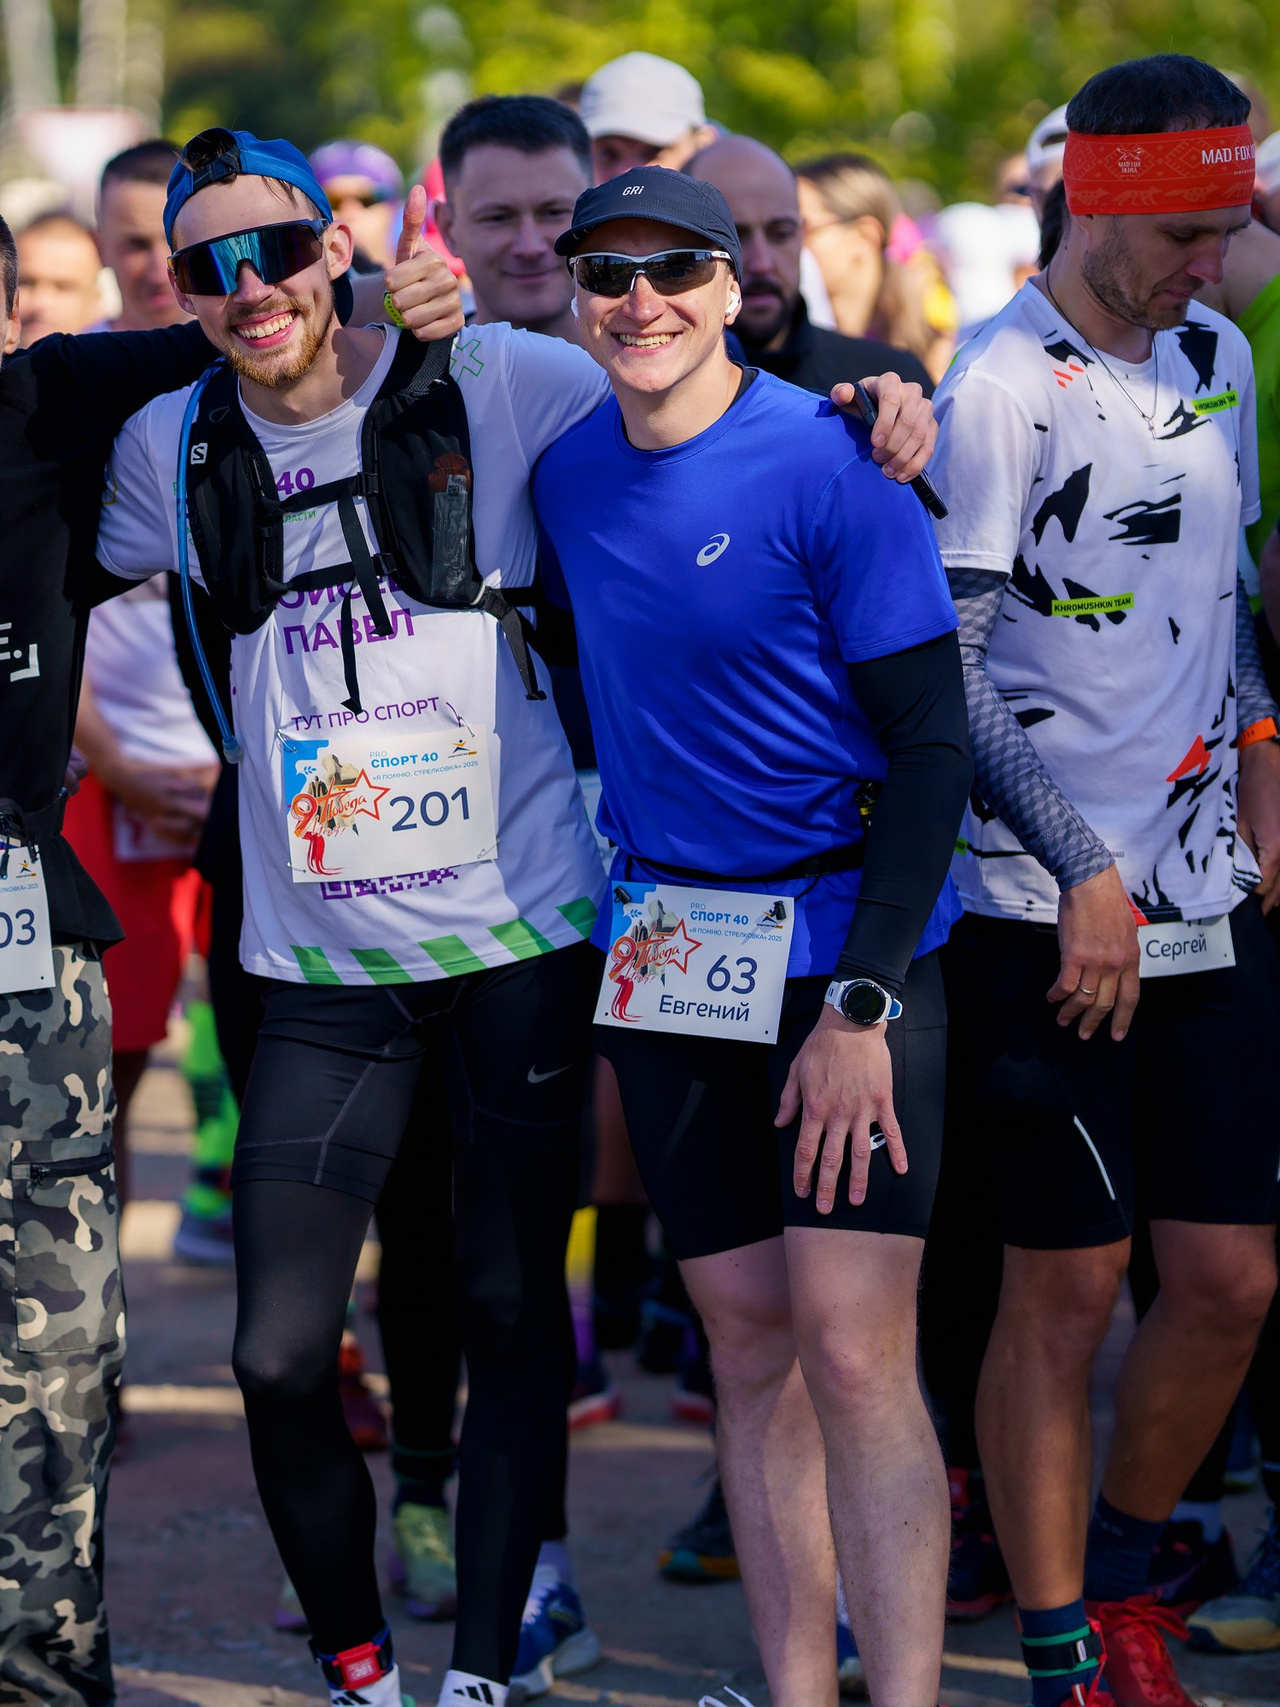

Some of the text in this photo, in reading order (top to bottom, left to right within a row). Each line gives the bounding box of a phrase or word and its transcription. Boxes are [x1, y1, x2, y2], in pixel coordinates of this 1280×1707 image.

[1201, 149, 1232, 164] MAD
[1234, 144, 1251, 161] FOX
[276, 467, 315, 495] 40
[282, 510, 316, 523] ЛАСТИ
[1054, 597, 1131, 612] KHROMUSHKIN TEAM
[283, 608, 414, 655] ПАВЕЛ
[291, 696, 439, 731] ТУТ ПРО СПОРТ
[369, 750, 388, 758] PRO
[371, 754, 418, 768] СПОРТ
[421, 752, 438, 763] 40
[463, 760, 479, 769] 2025
[389, 786, 470, 832] 201
[690, 902, 706, 910] PRO
[690, 910, 749, 925] СПОРТ 40
[1146, 935, 1207, 961] Сергей
[706, 954, 758, 994] 63
[658, 994, 750, 1022] Евгений
